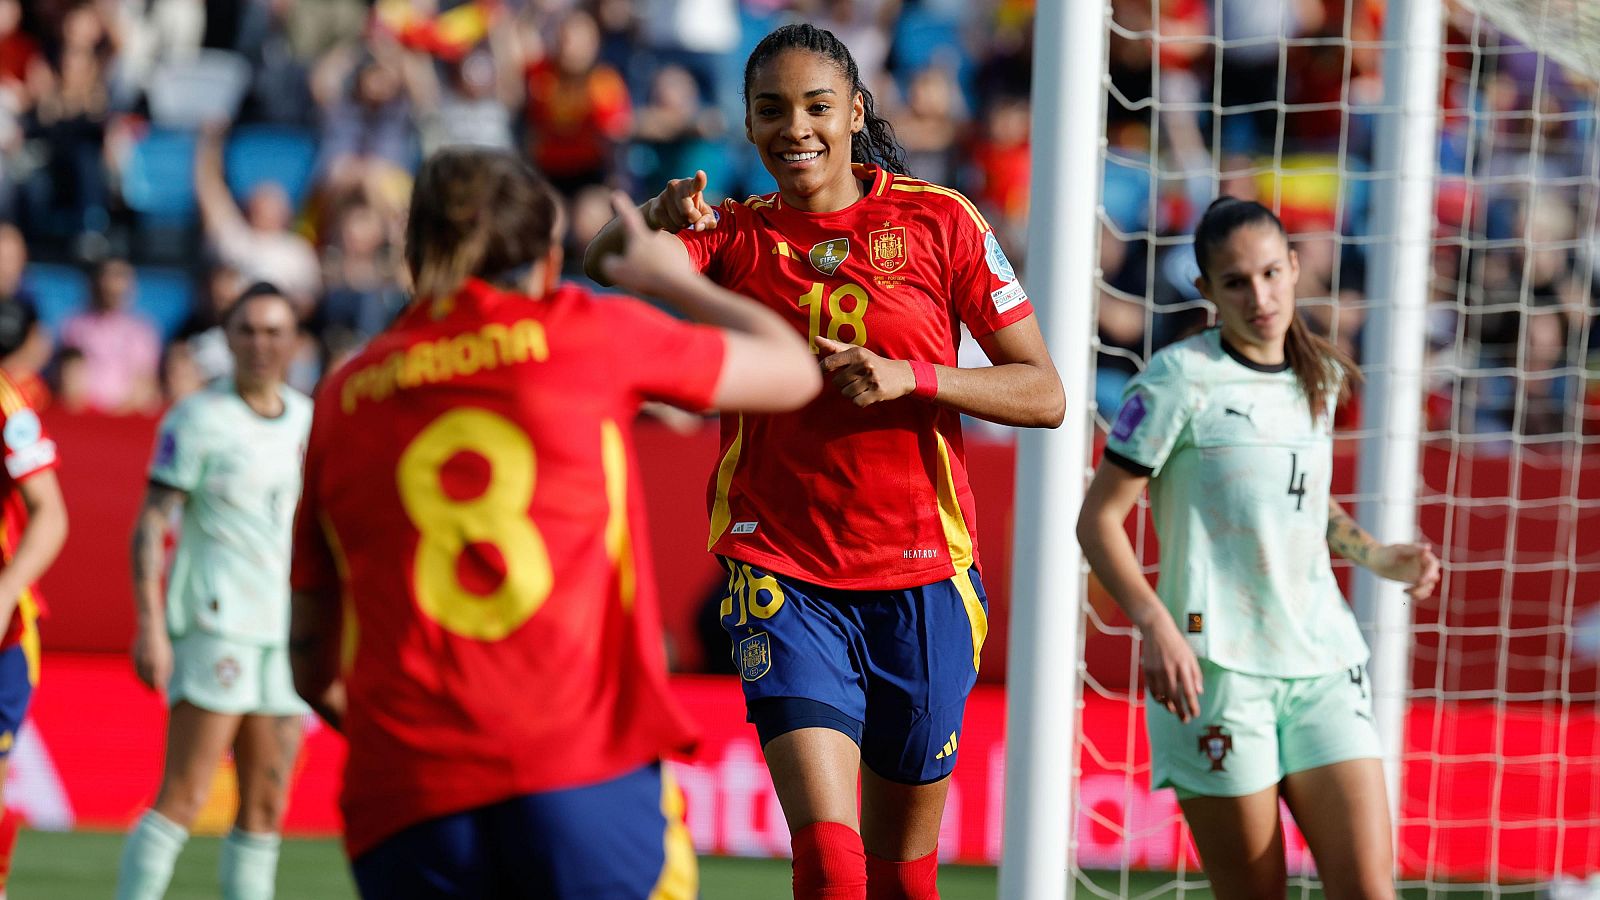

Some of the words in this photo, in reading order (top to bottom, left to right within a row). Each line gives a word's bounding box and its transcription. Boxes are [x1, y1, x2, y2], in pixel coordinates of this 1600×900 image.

[820, 256, 834, 265] FIFA
[798, 282, 869, 354] 18
[342, 318, 549, 414] MARIONA
[1286, 451, 1307, 511] 4
[396, 407, 554, 642] 8
[902, 549, 938, 560] HEAT.RDY
